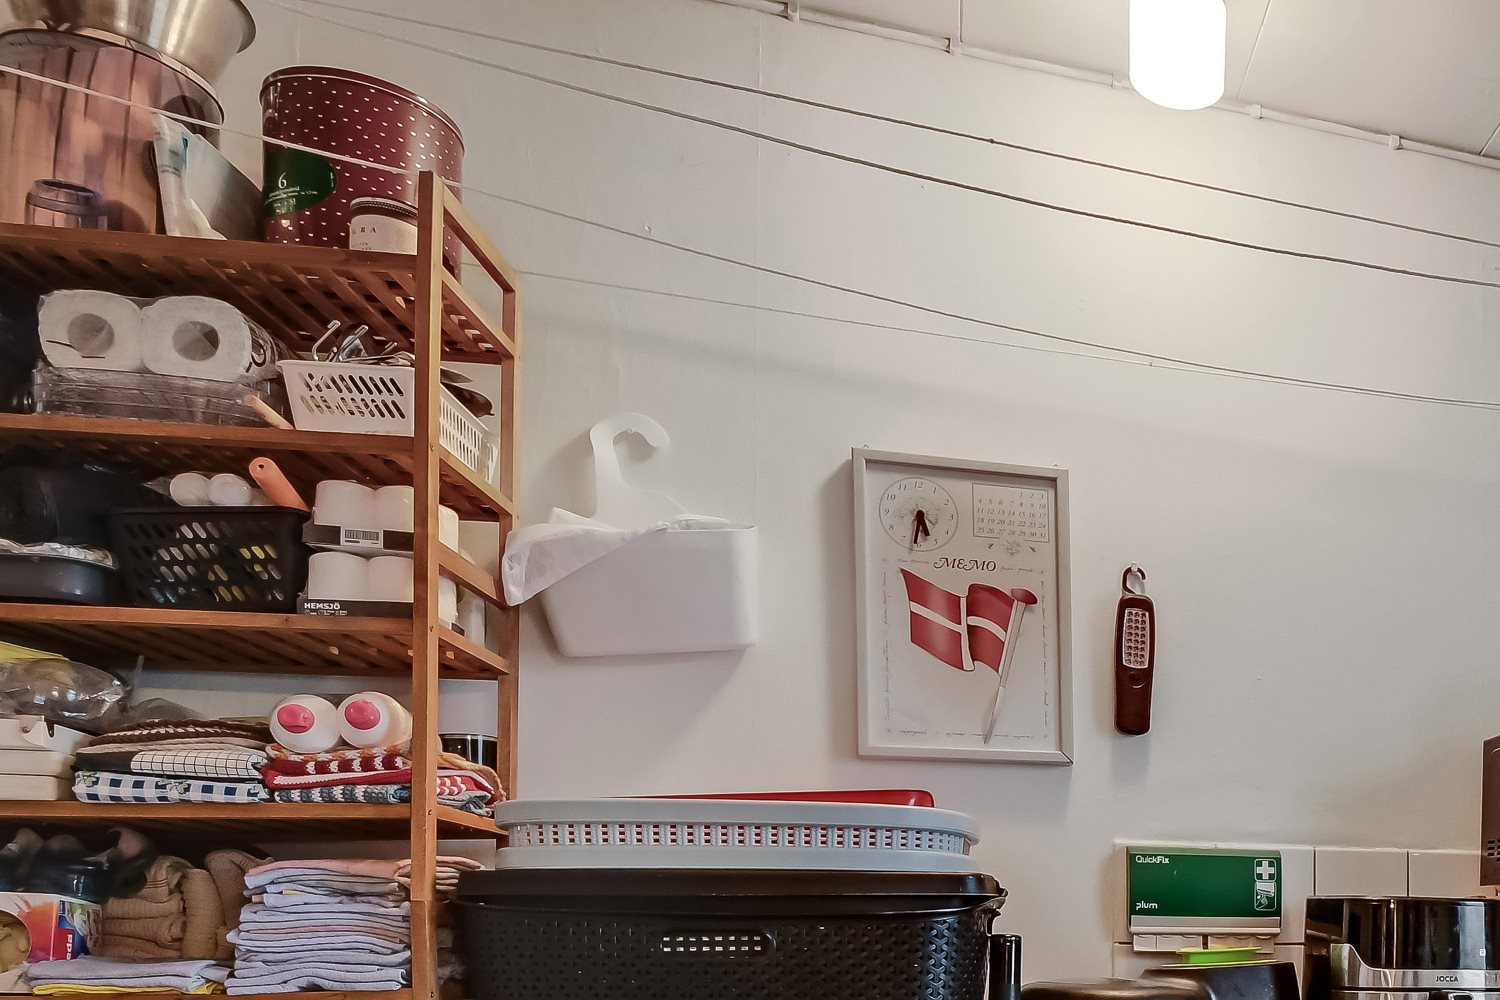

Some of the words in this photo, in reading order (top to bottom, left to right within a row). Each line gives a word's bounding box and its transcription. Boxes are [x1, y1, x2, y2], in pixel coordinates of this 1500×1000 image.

[278, 172, 287, 189] 6
[933, 557, 997, 572] MEMO
[304, 602, 341, 610] HEMSJÖ
[1135, 855, 1170, 864] QuickFix
[1135, 900, 1158, 911] plum
